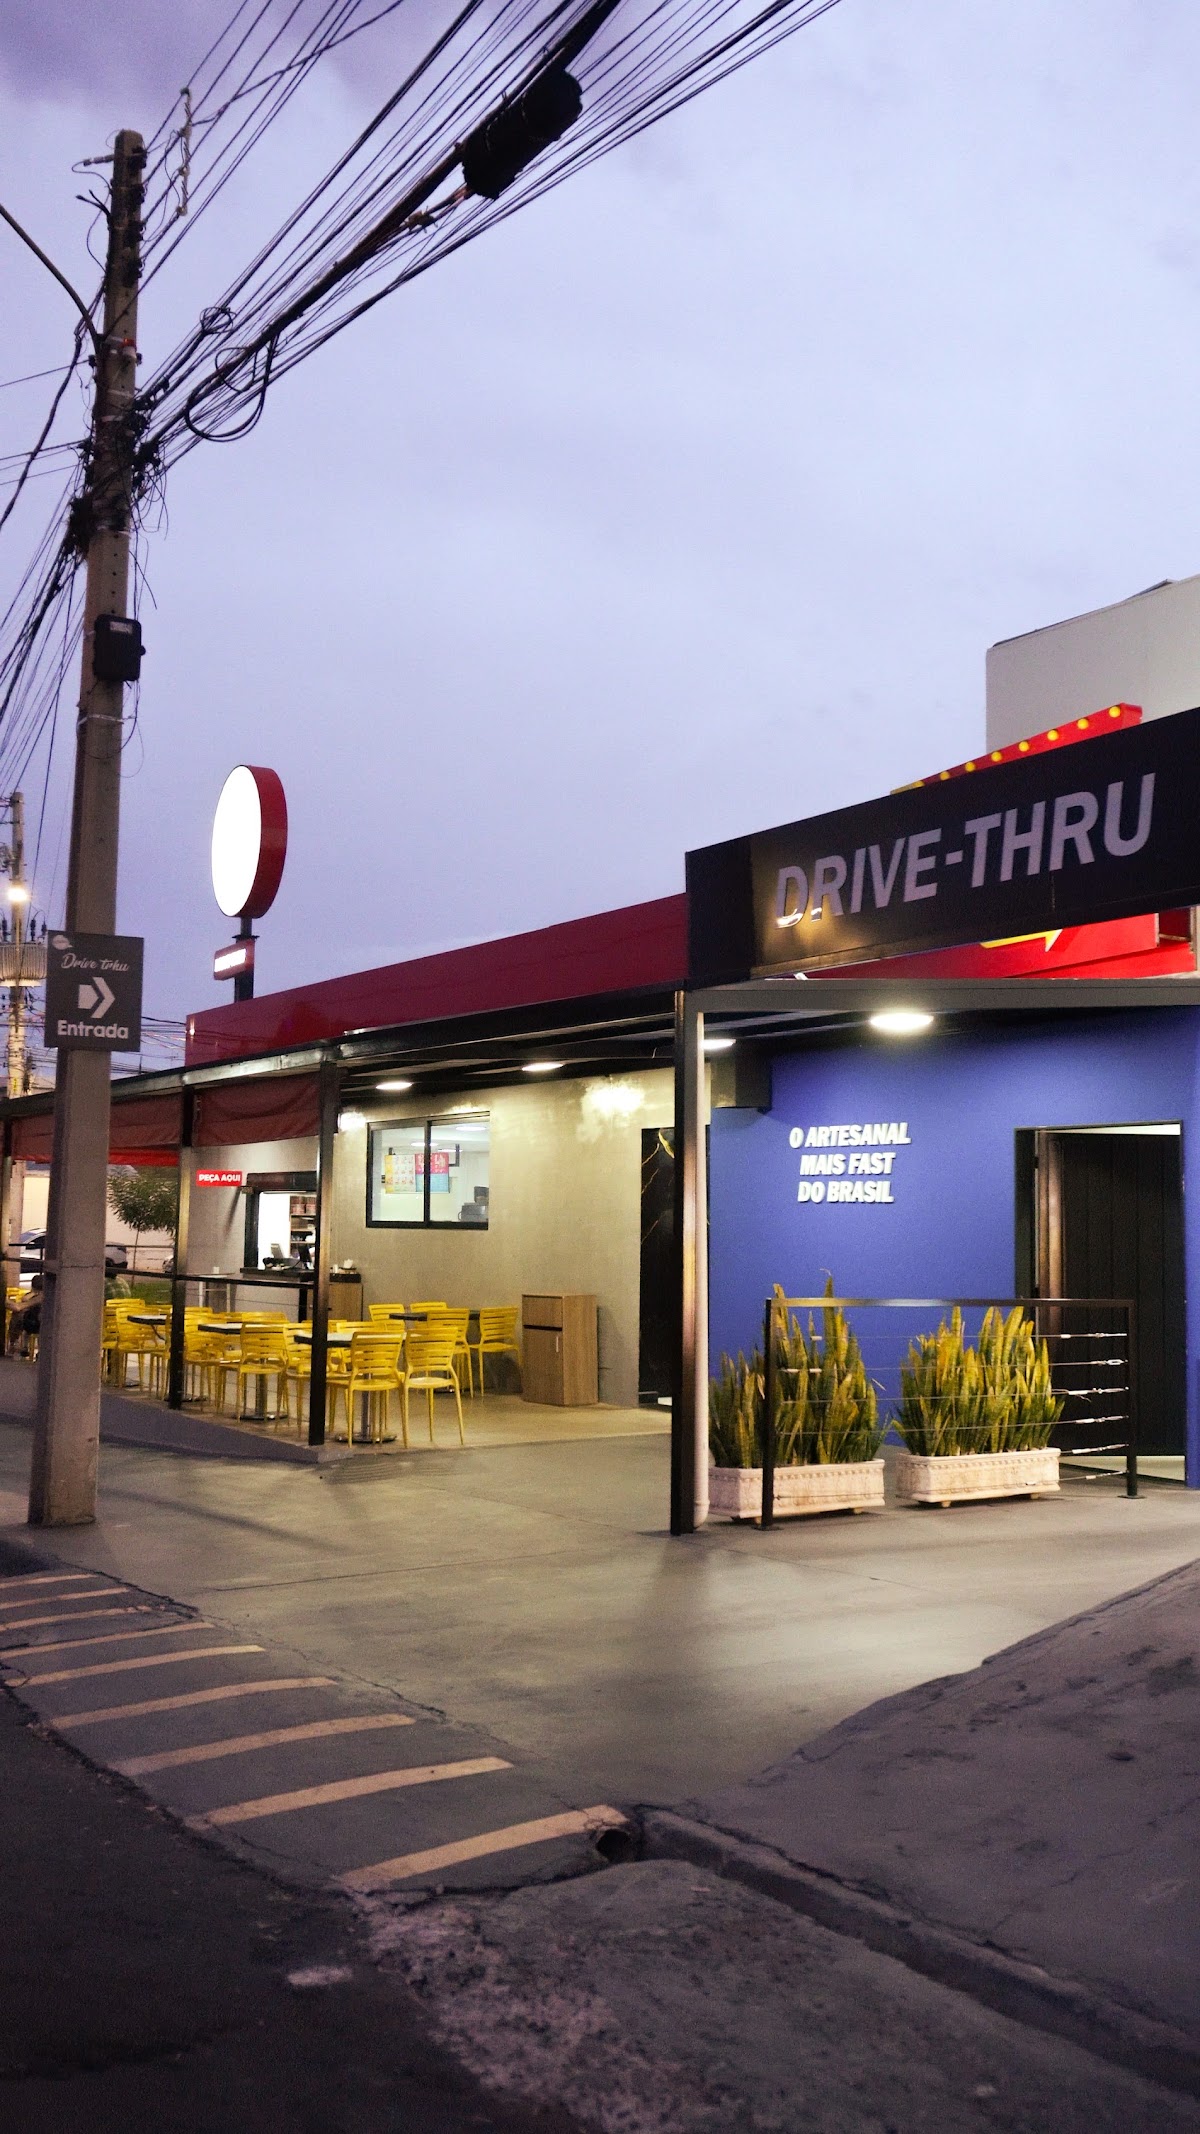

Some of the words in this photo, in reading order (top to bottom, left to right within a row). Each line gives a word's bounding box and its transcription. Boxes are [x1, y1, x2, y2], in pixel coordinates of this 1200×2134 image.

[774, 773, 1156, 930] DRIVE-THRU
[61, 952, 97, 969] Drive
[57, 1019, 129, 1039] Entrada
[789, 1127, 804, 1148] O
[805, 1123, 911, 1147] ARTESANAL
[799, 1153, 847, 1176] MAIS
[848, 1152, 896, 1175] FAST
[199, 1174, 219, 1183] PEÇA
[220, 1174, 240, 1182] AQUI
[797, 1181, 826, 1204] DO
[827, 1180, 895, 1204] BRASIL
